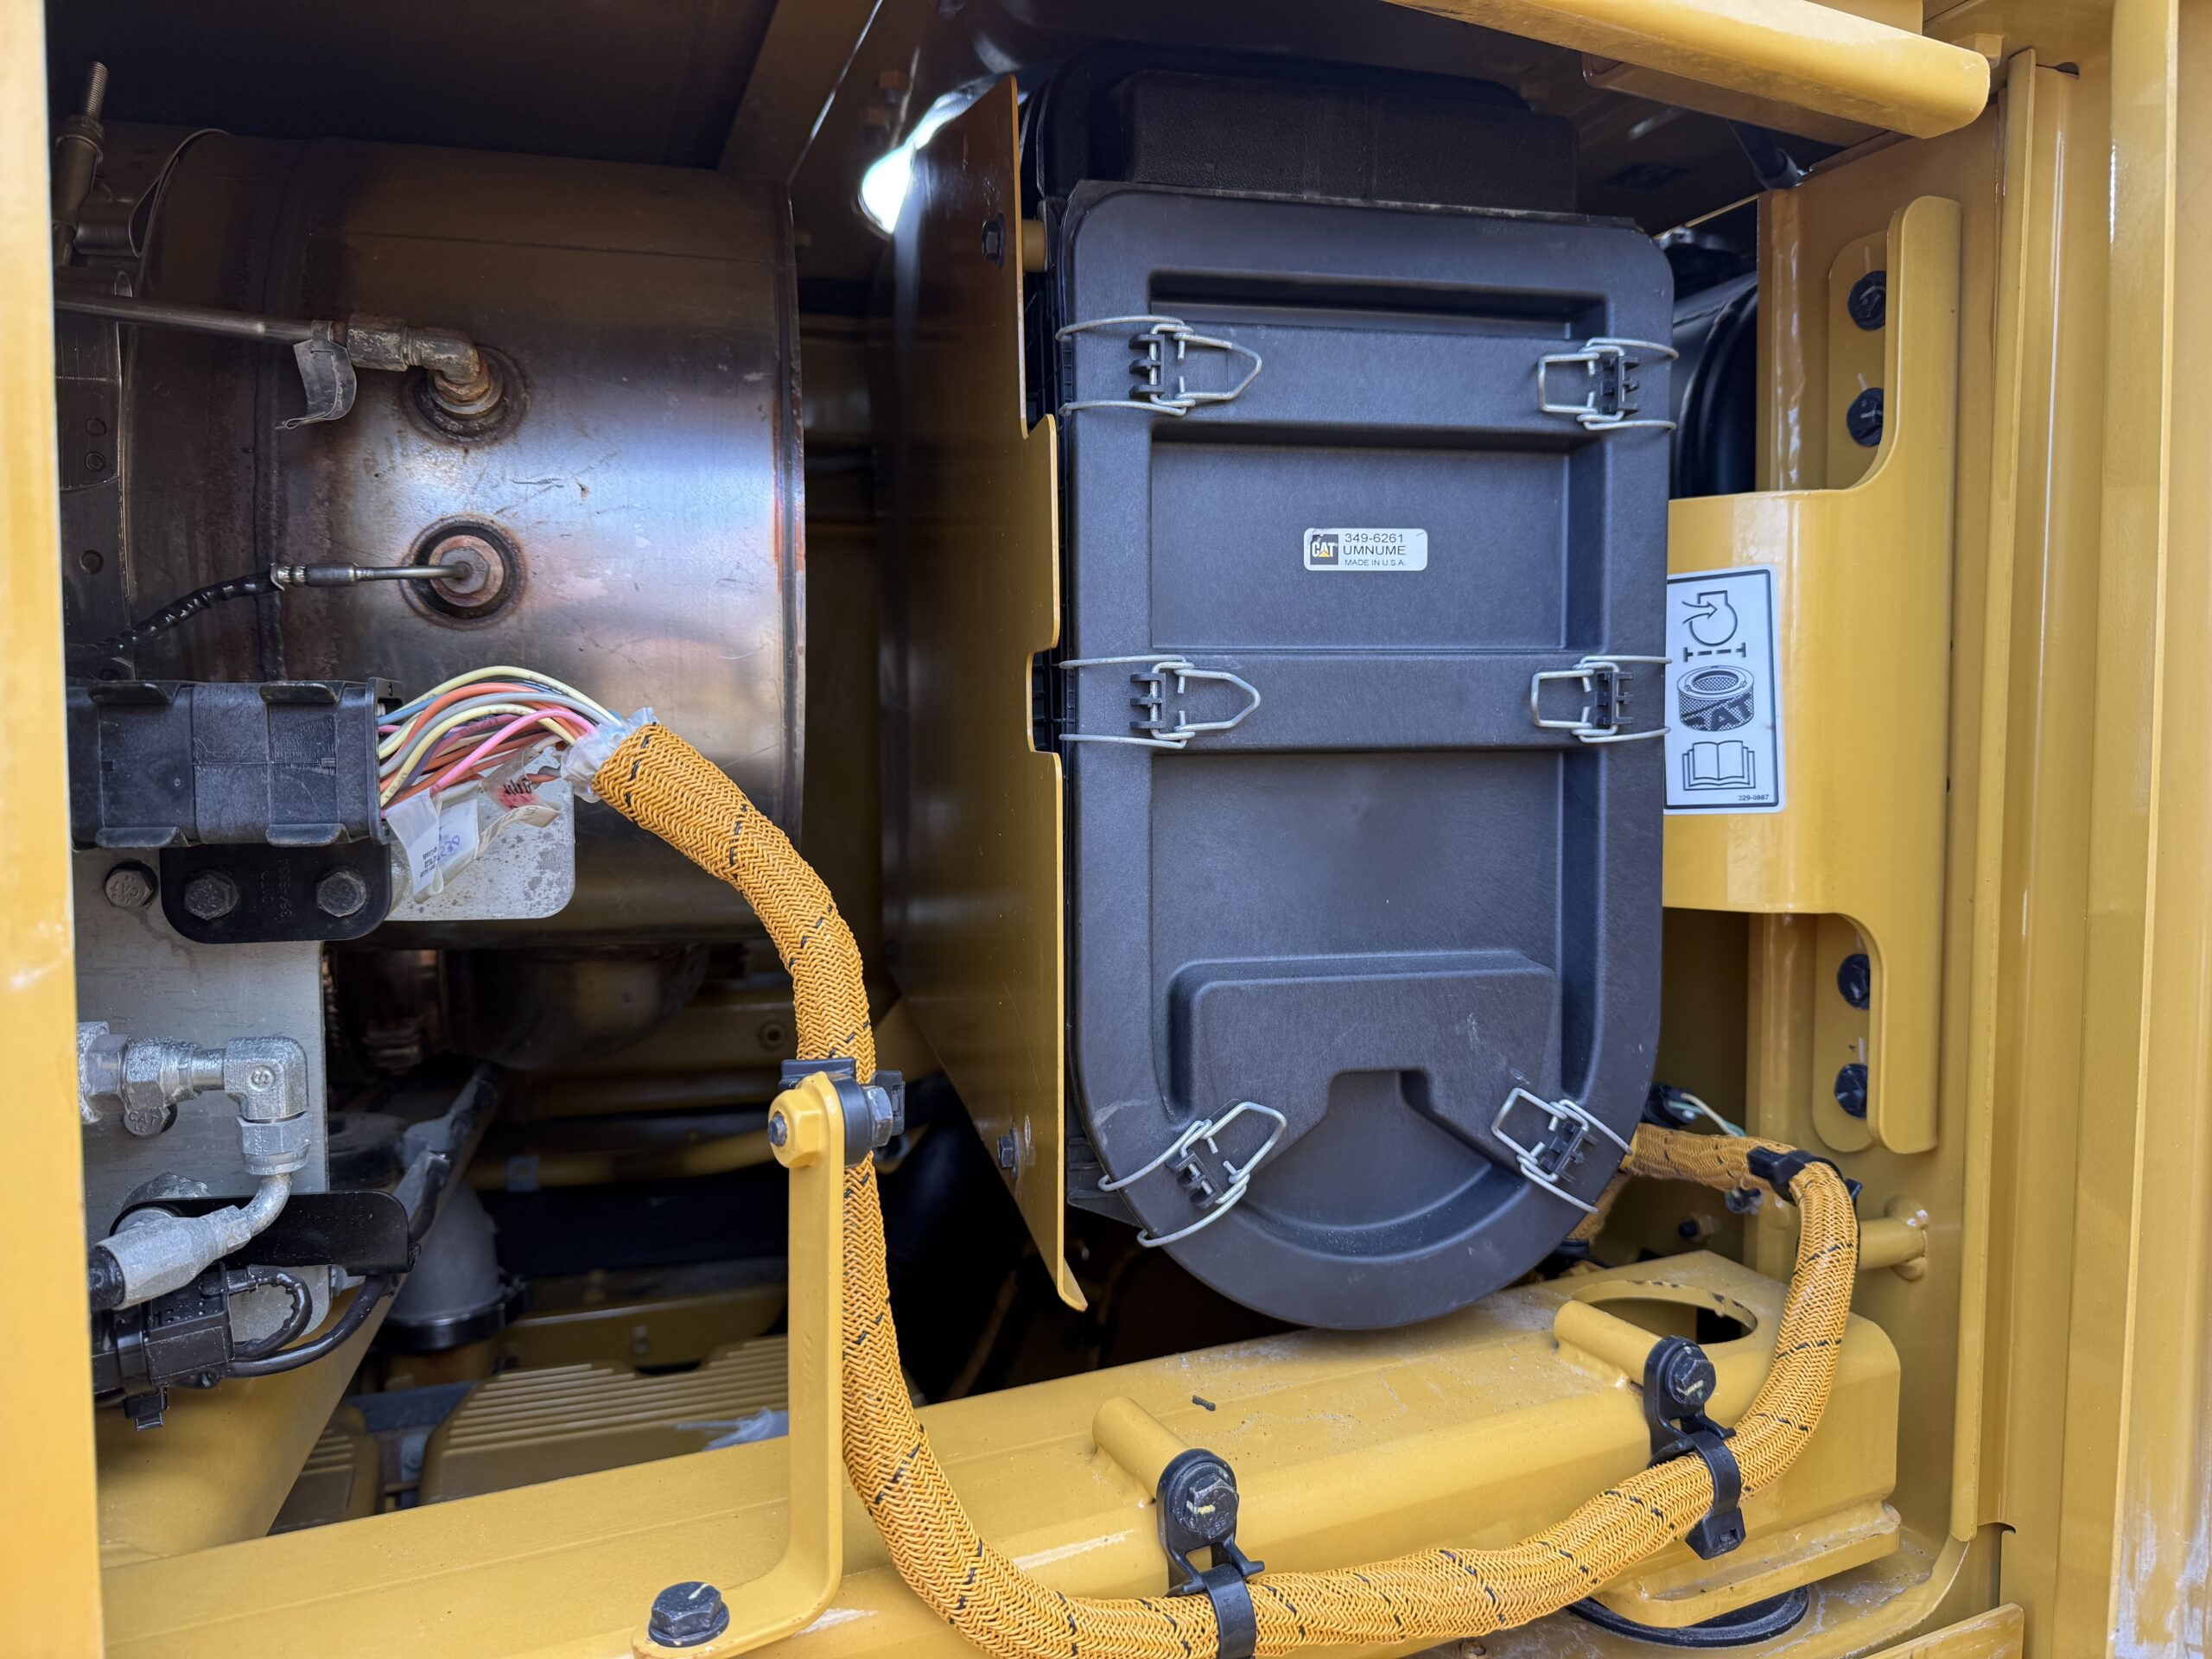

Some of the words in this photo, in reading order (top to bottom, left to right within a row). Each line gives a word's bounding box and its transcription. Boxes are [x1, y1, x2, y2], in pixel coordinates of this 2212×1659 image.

[1344, 533, 1404, 543] 349-6261
[1312, 541, 1337, 558] CAT
[1343, 545, 1407, 556] UMNUME
[129, 1109, 159, 1126] CAT
